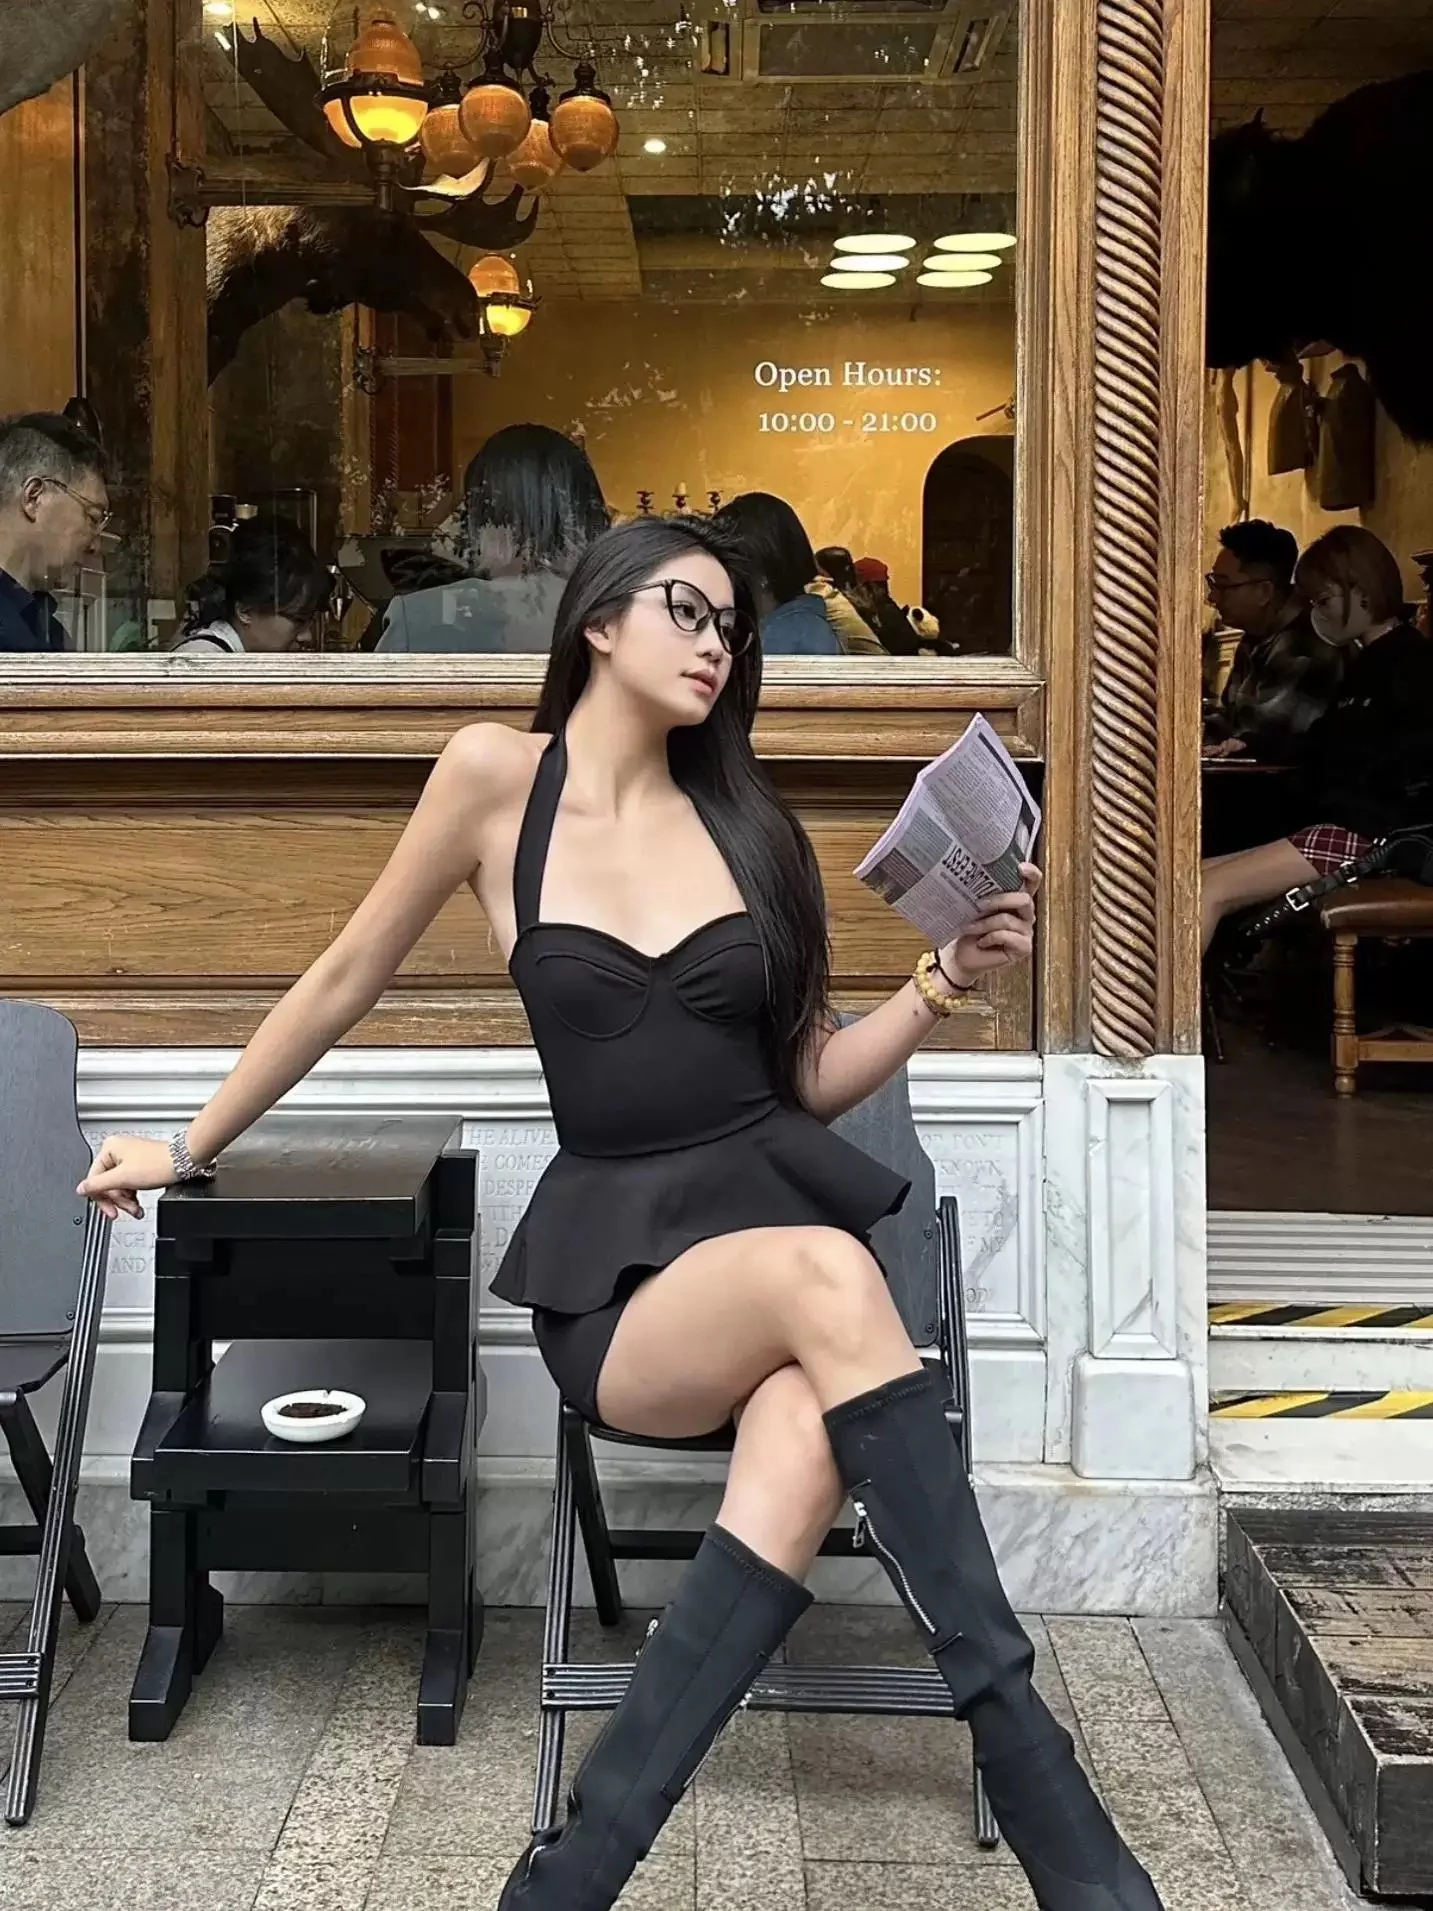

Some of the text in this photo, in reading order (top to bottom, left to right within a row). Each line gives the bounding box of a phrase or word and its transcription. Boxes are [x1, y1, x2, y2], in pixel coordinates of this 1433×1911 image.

[754, 361, 941, 392] Open Hours:
[758, 412, 835, 432] 10:00
[862, 412, 937, 432] 21:00
